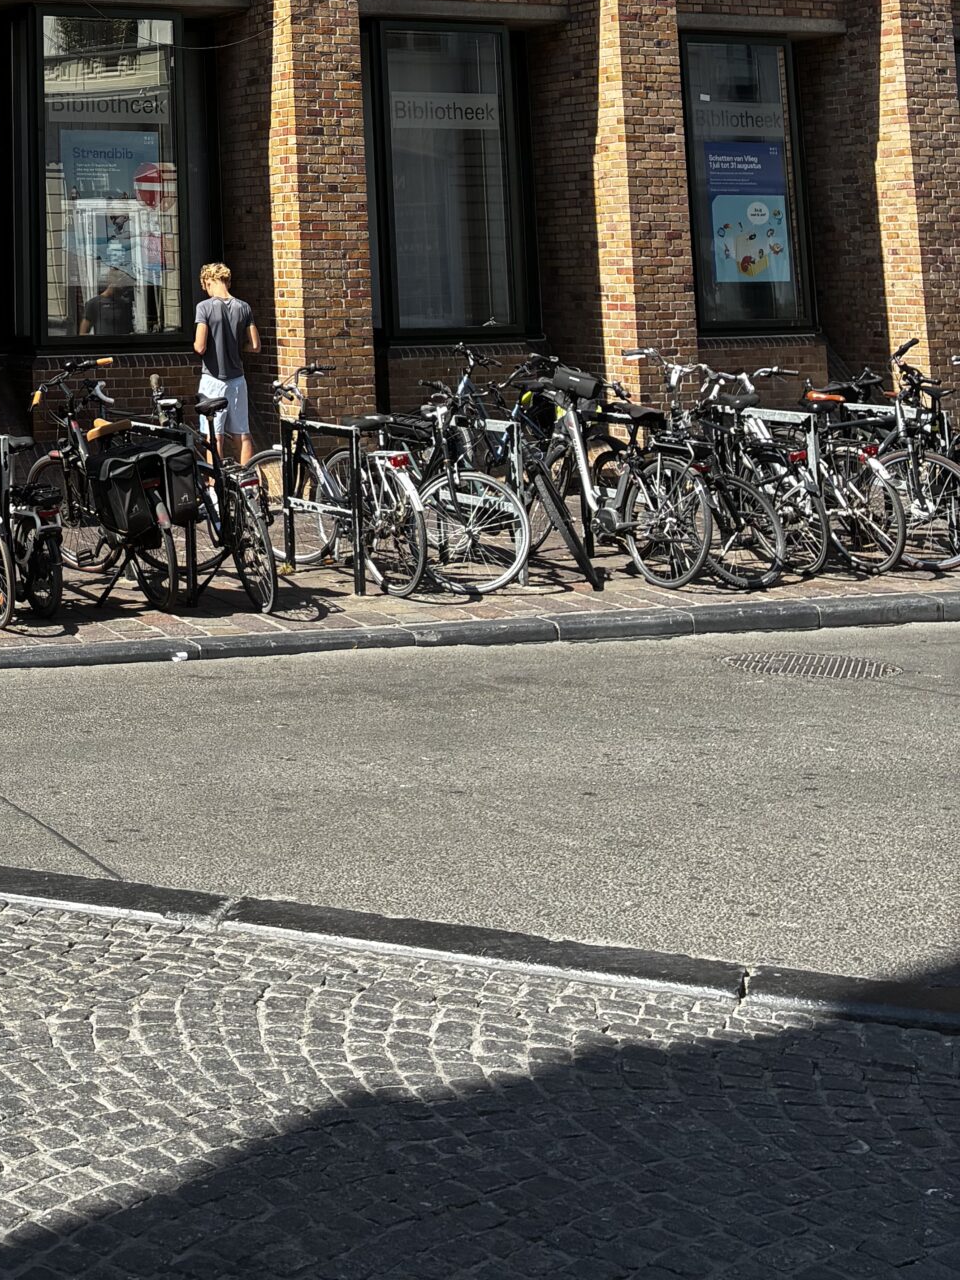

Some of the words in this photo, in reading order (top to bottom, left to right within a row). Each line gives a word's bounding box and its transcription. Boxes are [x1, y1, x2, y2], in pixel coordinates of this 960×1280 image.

[51, 93, 165, 115] Bibliotheek
[394, 100, 495, 121] Bibliotheek
[695, 109, 782, 129] Bibliotheek
[72, 147, 134, 159] Strandbib
